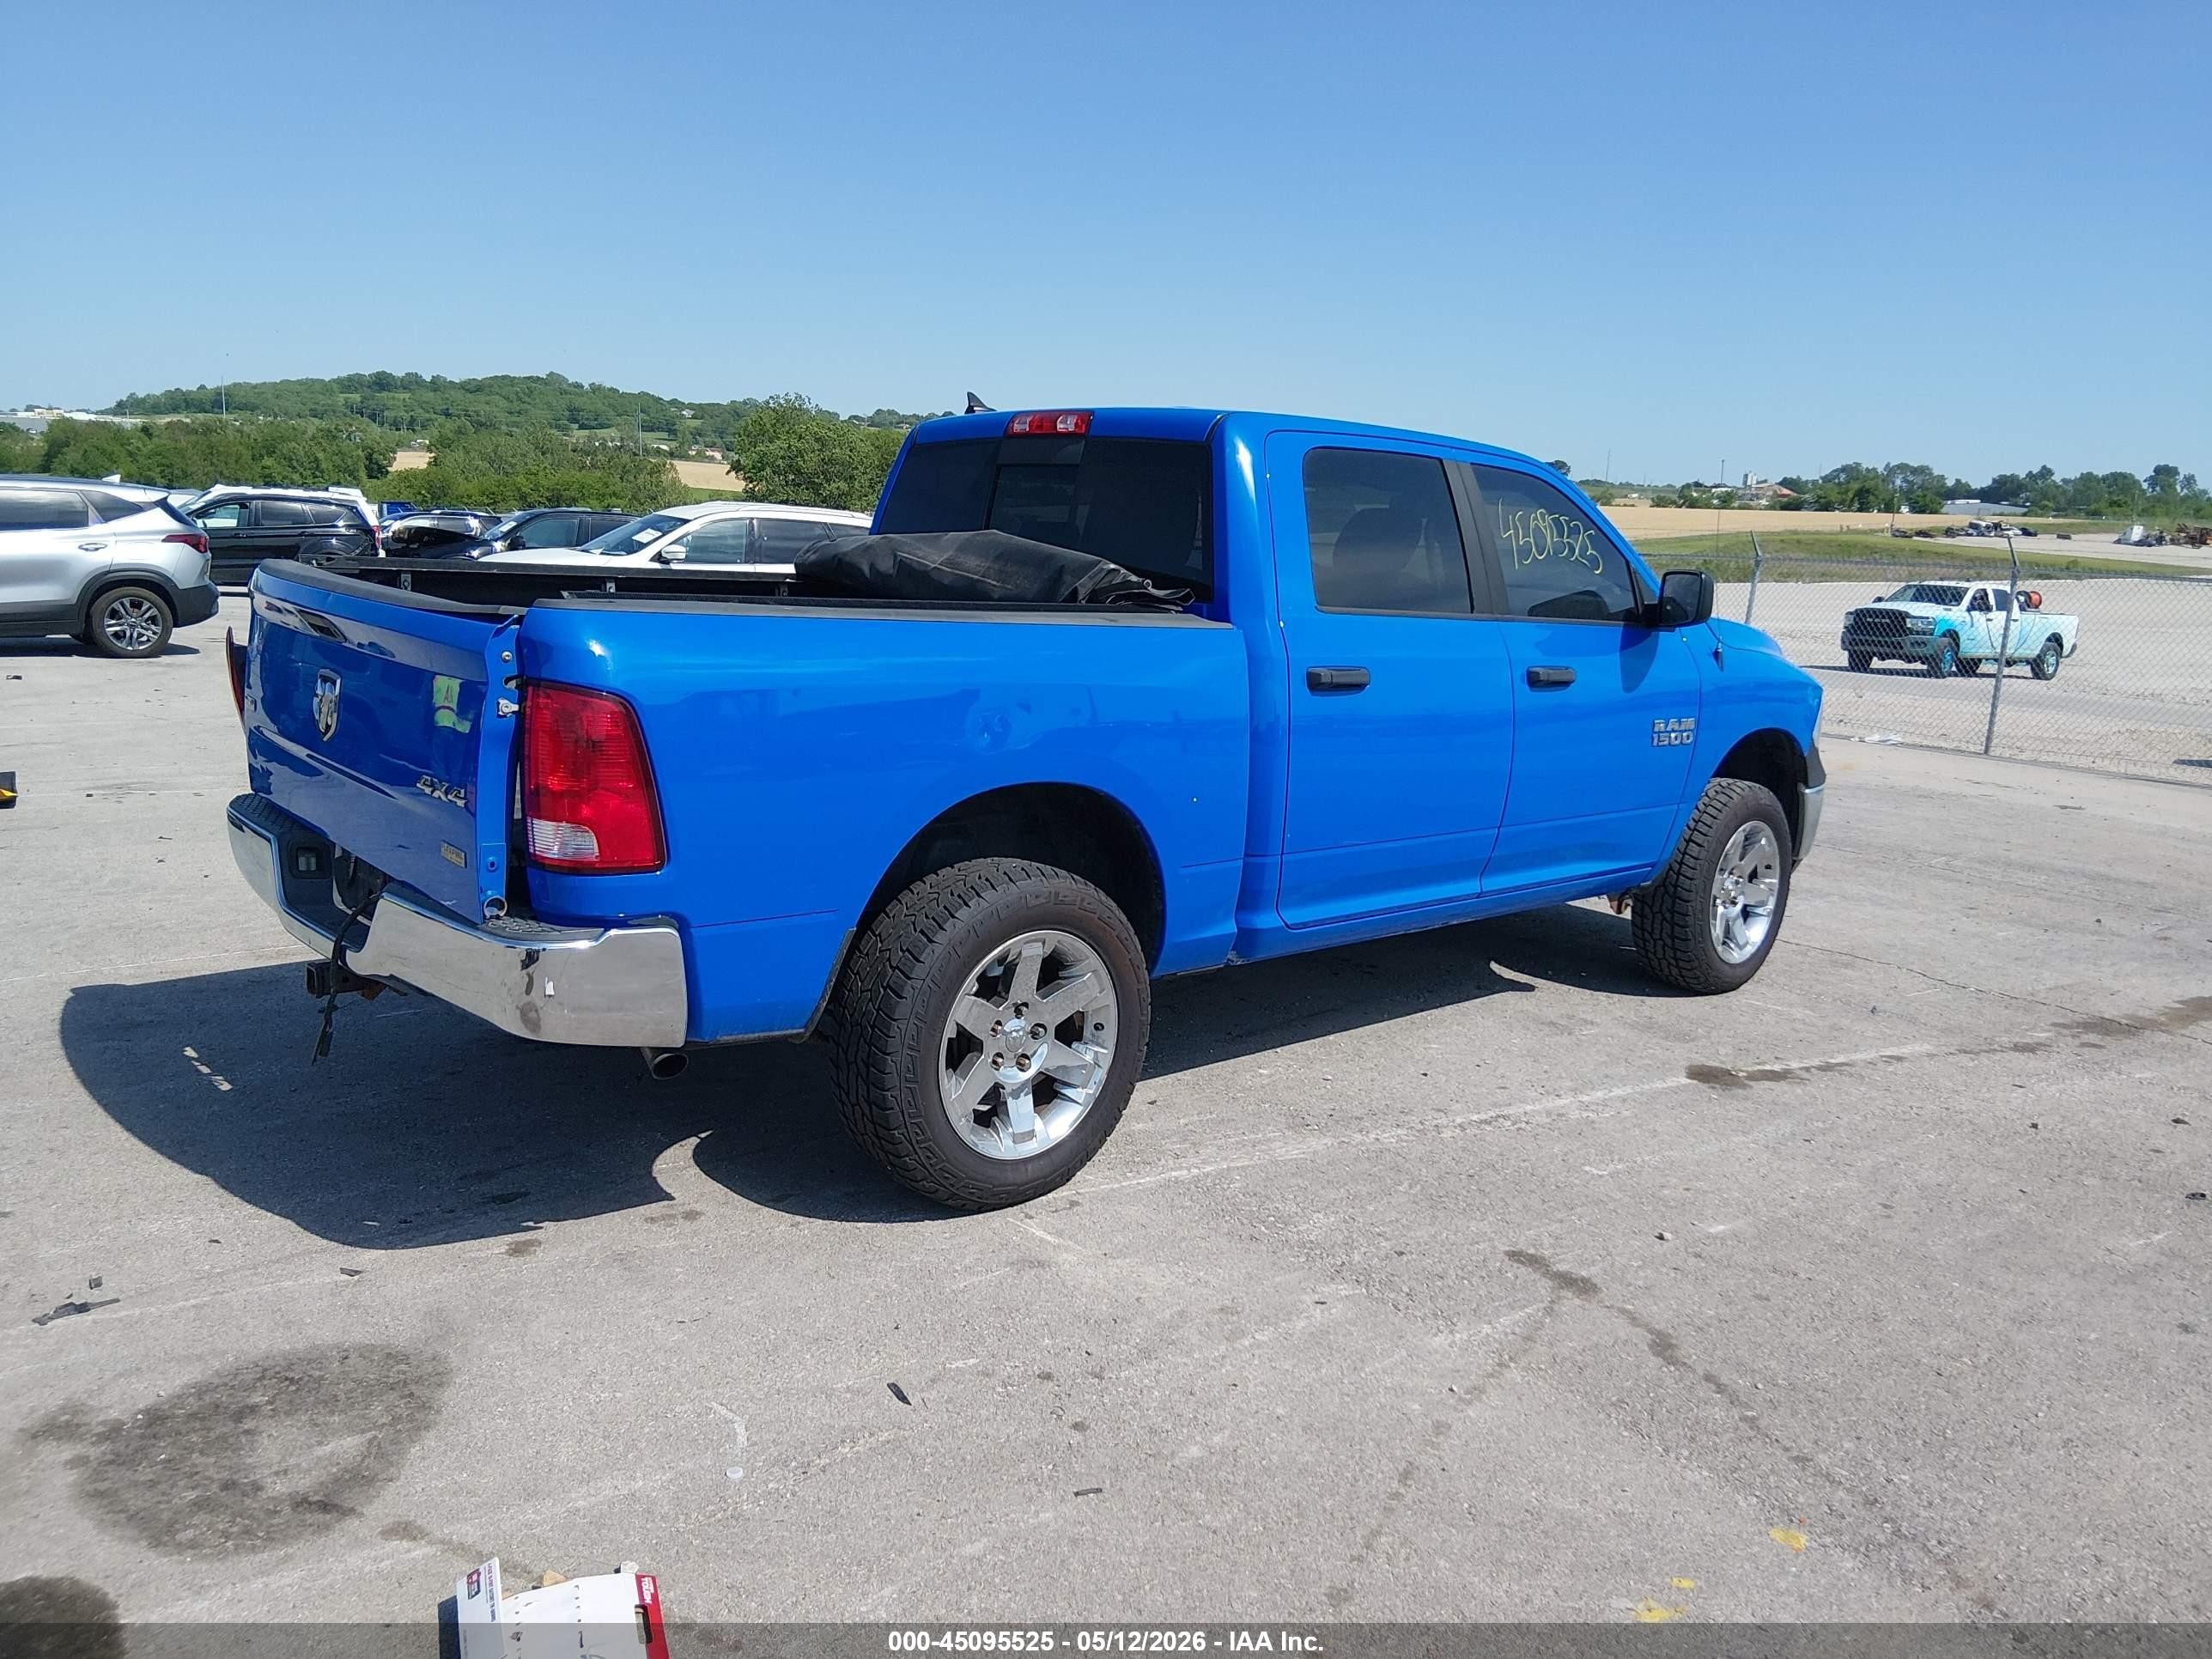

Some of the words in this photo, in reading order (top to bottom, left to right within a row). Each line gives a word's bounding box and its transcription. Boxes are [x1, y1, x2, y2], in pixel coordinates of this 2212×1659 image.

[1498, 498, 1603, 574] 45095525
[1653, 717, 1695, 732] RAM
[1652, 732, 1693, 746] 1500
[641, 1577, 652, 1604] TOUGH
